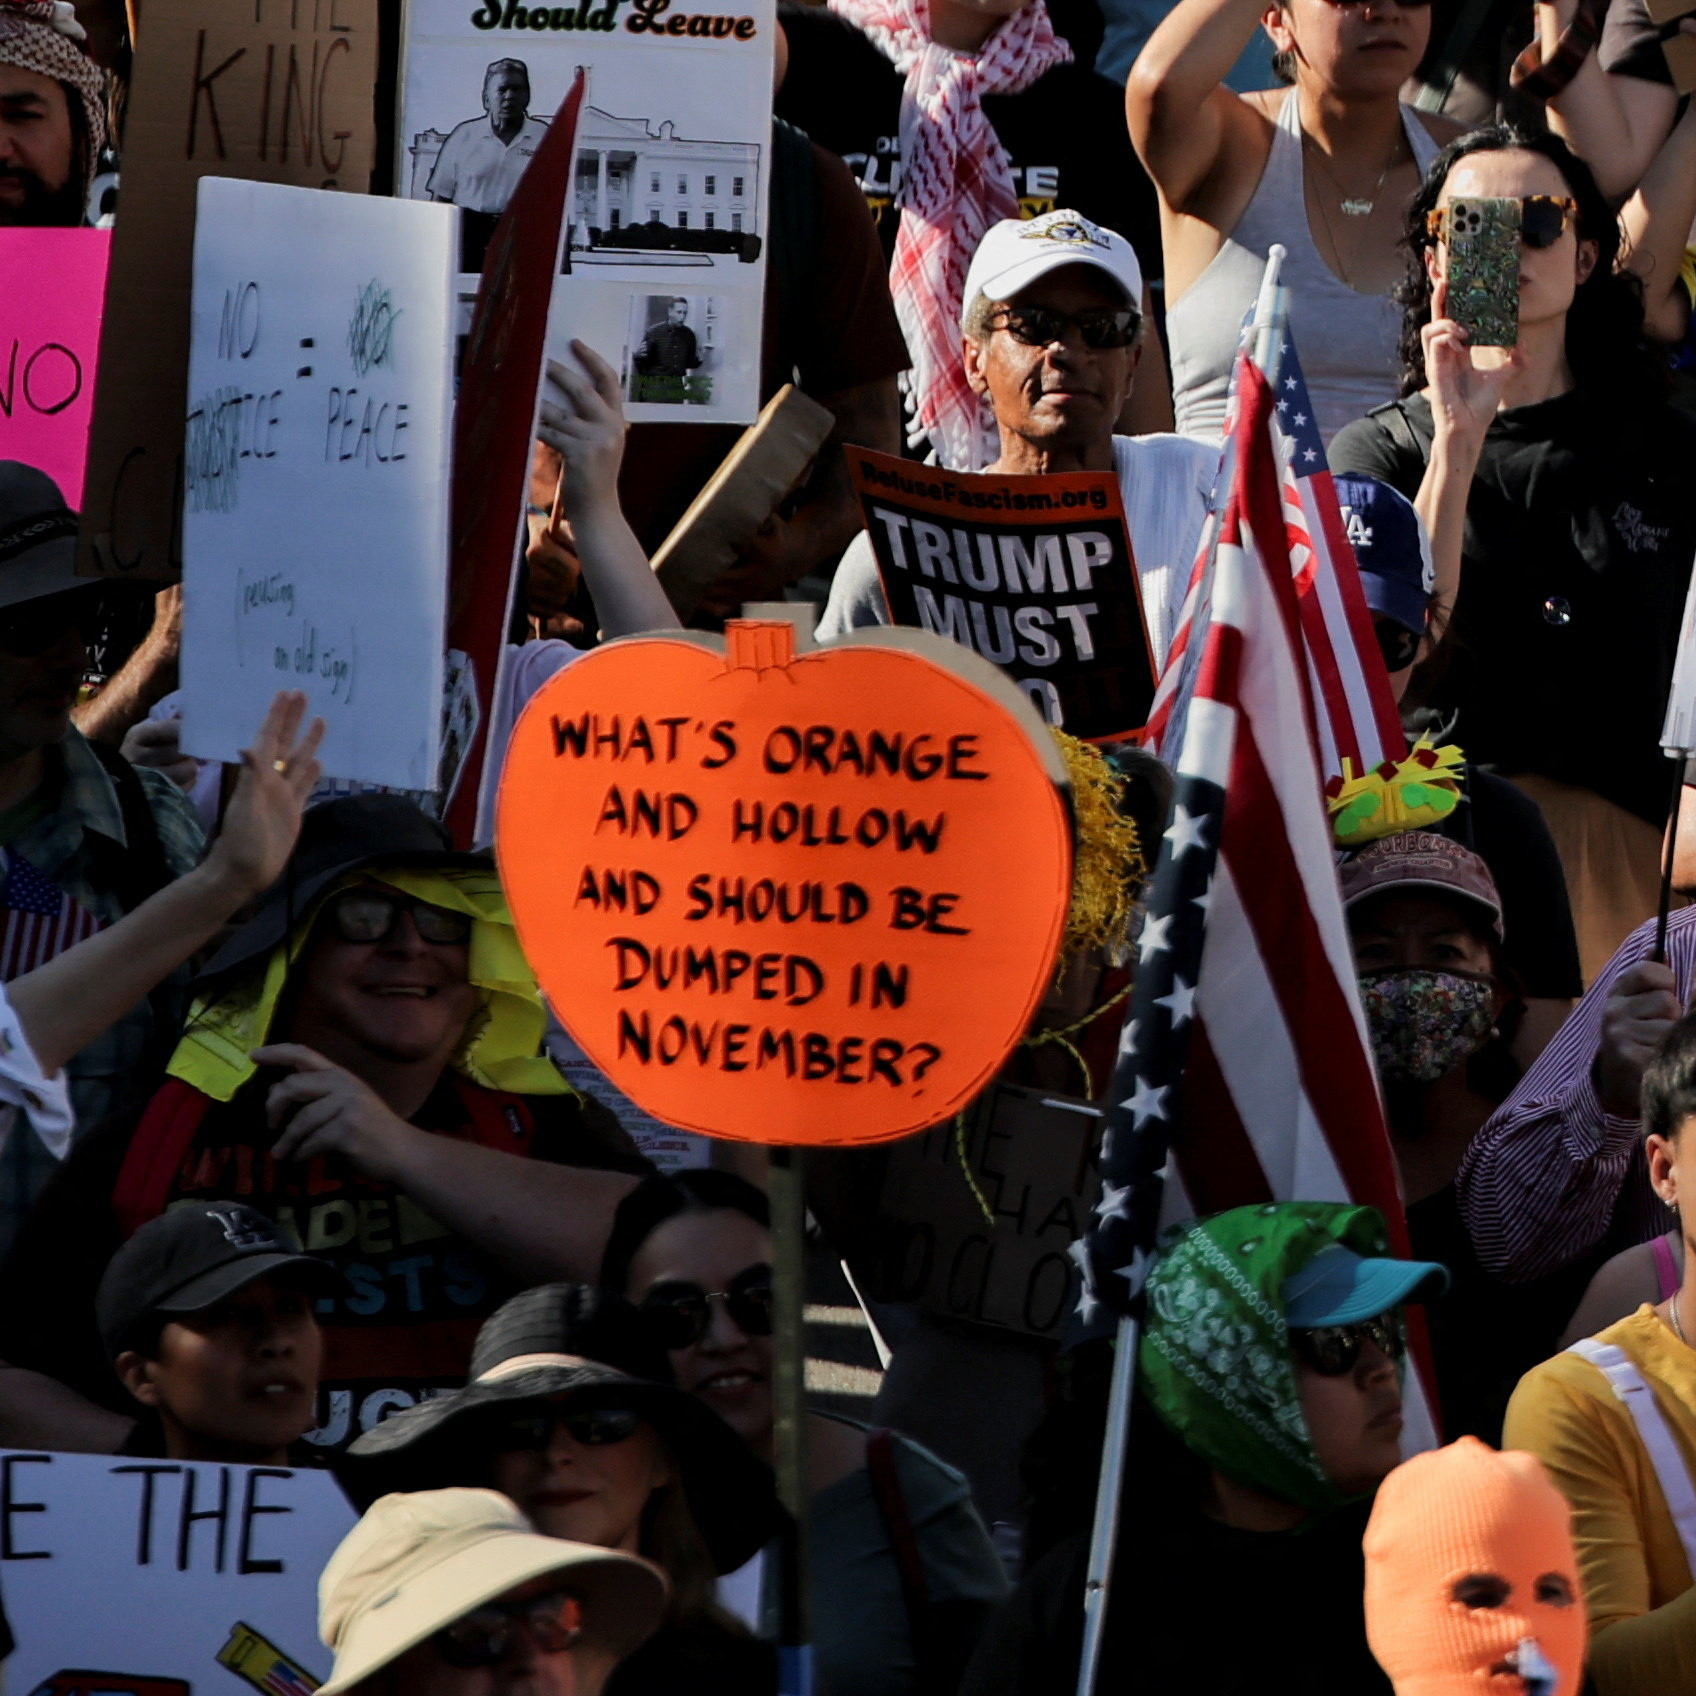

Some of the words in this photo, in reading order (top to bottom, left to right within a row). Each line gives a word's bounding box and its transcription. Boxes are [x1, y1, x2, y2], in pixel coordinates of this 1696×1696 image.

[188, 28, 352, 174] KING
[217, 279, 261, 362] NO
[324, 385, 410, 470] PEACE
[861, 460, 1108, 511] RefuseFascism.org
[872, 505, 1114, 594] TRUMP
[911, 583, 1100, 668] MUST
[549, 710, 736, 772] WHAT'S
[761, 723, 990, 782] ORANGE
[595, 784, 699, 842] AND
[731, 798, 948, 856] HOLLOW
[575, 864, 663, 916] AND
[684, 872, 870, 927] SHOULD
[887, 886, 973, 937] BE
[604, 936, 826, 1007] DUMPED
[849, 961, 911, 1010] IN
[616, 1008, 944, 1100] NOVEMBER?
[107, 1463, 298, 1577] THE
